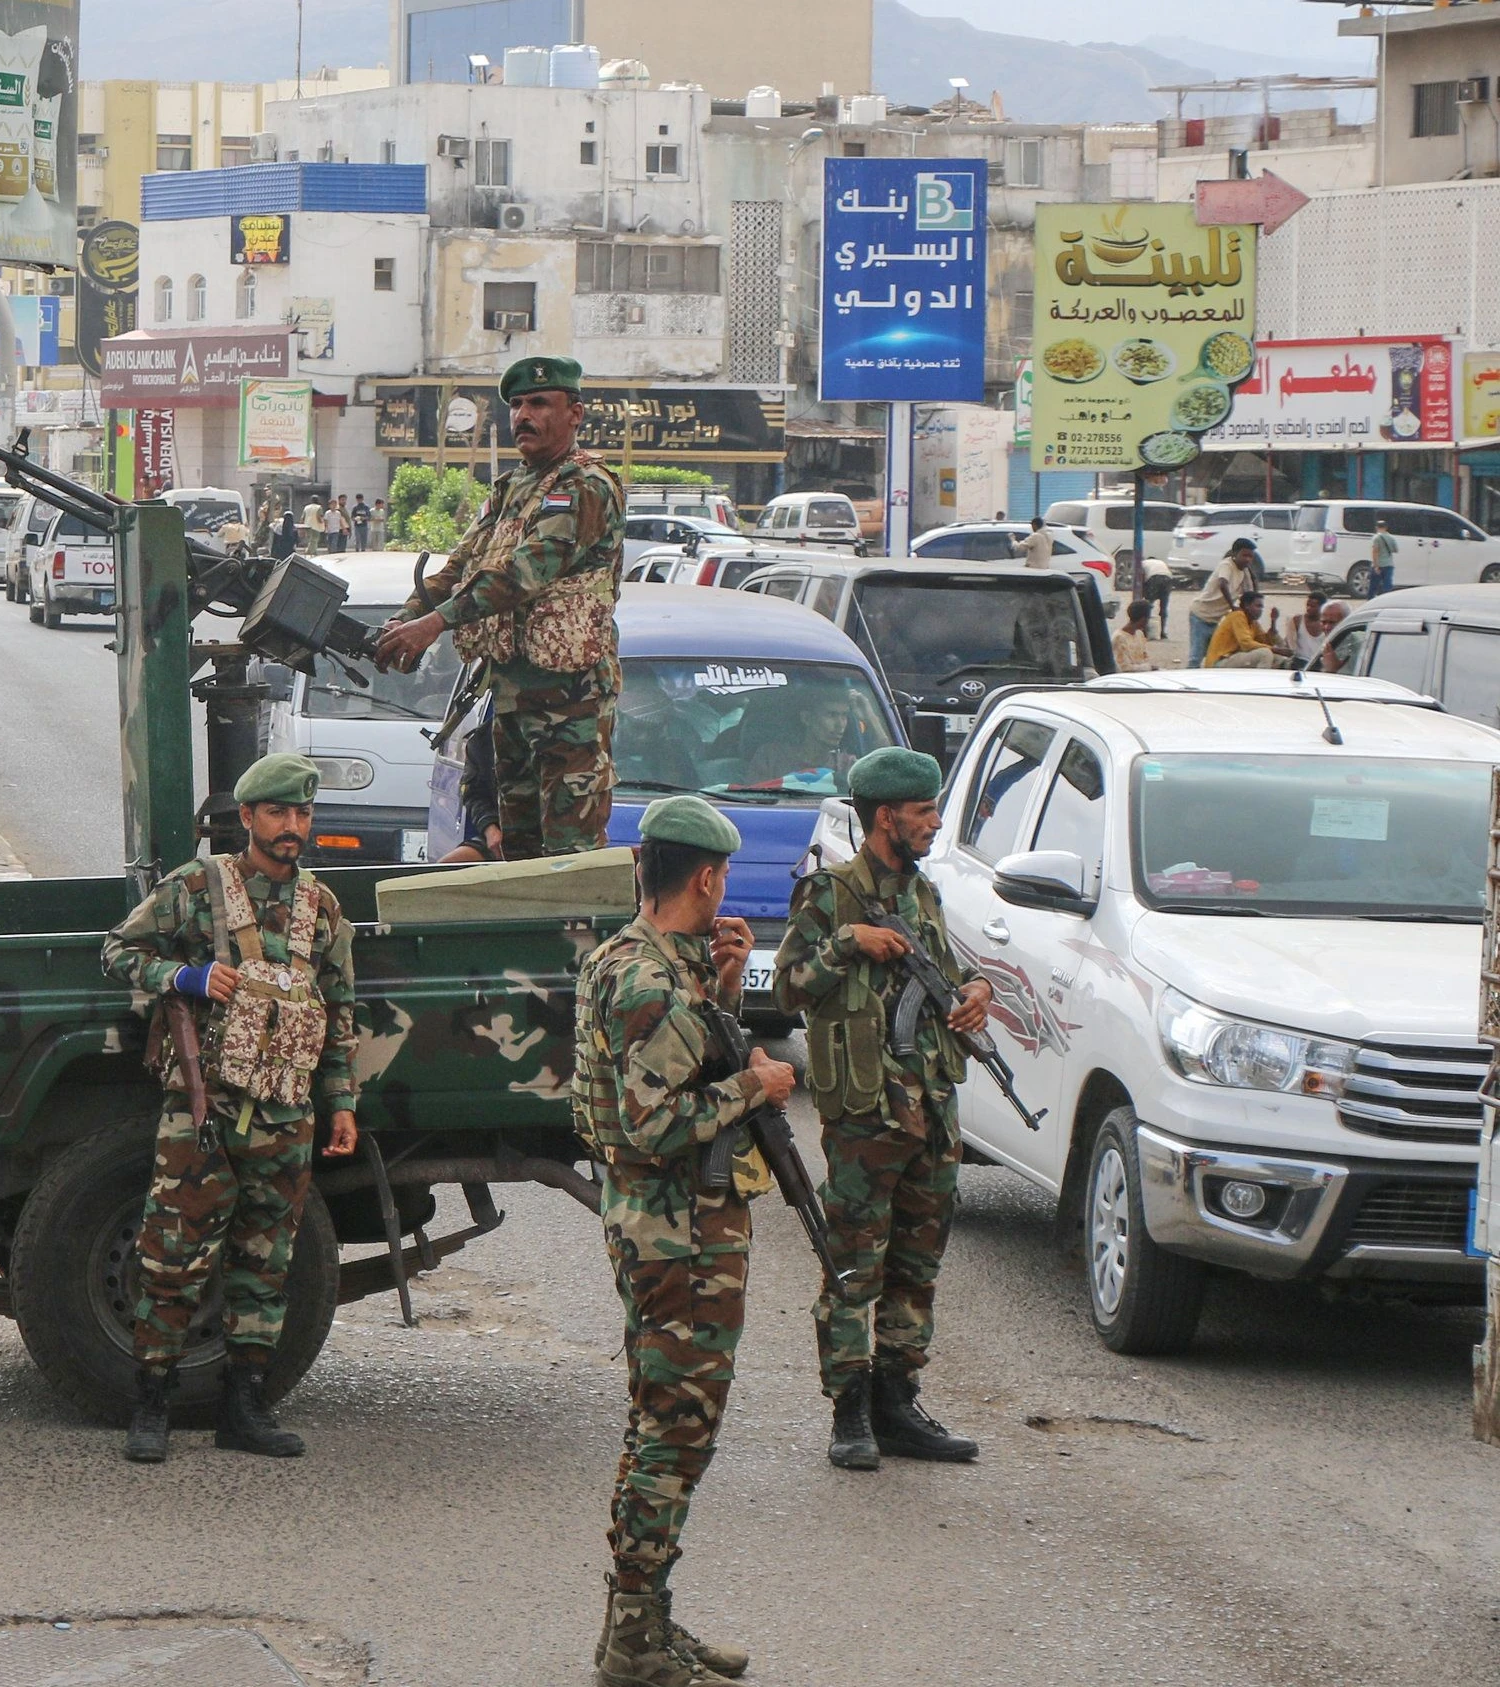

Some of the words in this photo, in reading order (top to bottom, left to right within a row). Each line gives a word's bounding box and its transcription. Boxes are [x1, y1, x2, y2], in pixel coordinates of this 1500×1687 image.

[836, 188, 908, 220] بنك
[835, 237, 973, 271] البسيري
[1055, 227, 1242, 297] تلبينة
[834, 284, 972, 316] الدولي
[1050, 299, 1136, 324] والعريكة
[1141, 299, 1244, 324] للمعصوب
[105, 350, 125, 370] ADEN
[126, 350, 153, 370] ISLAMIC
[155, 350, 176, 369] BANK
[844, 358, 875, 368] عالمية
[904, 358, 941, 369] مصرفية
[943, 358, 961, 368] ثقة
[1280, 353, 1377, 409] مطعم
[160, 408, 173, 438] ISLA
[665, 400, 697, 423] نور
[1071, 433, 1122, 442] 02-278556
[160, 441, 172, 478] ADEN
[1071, 446, 1123, 455] 772117523
[82, 562, 115, 575] TOY
